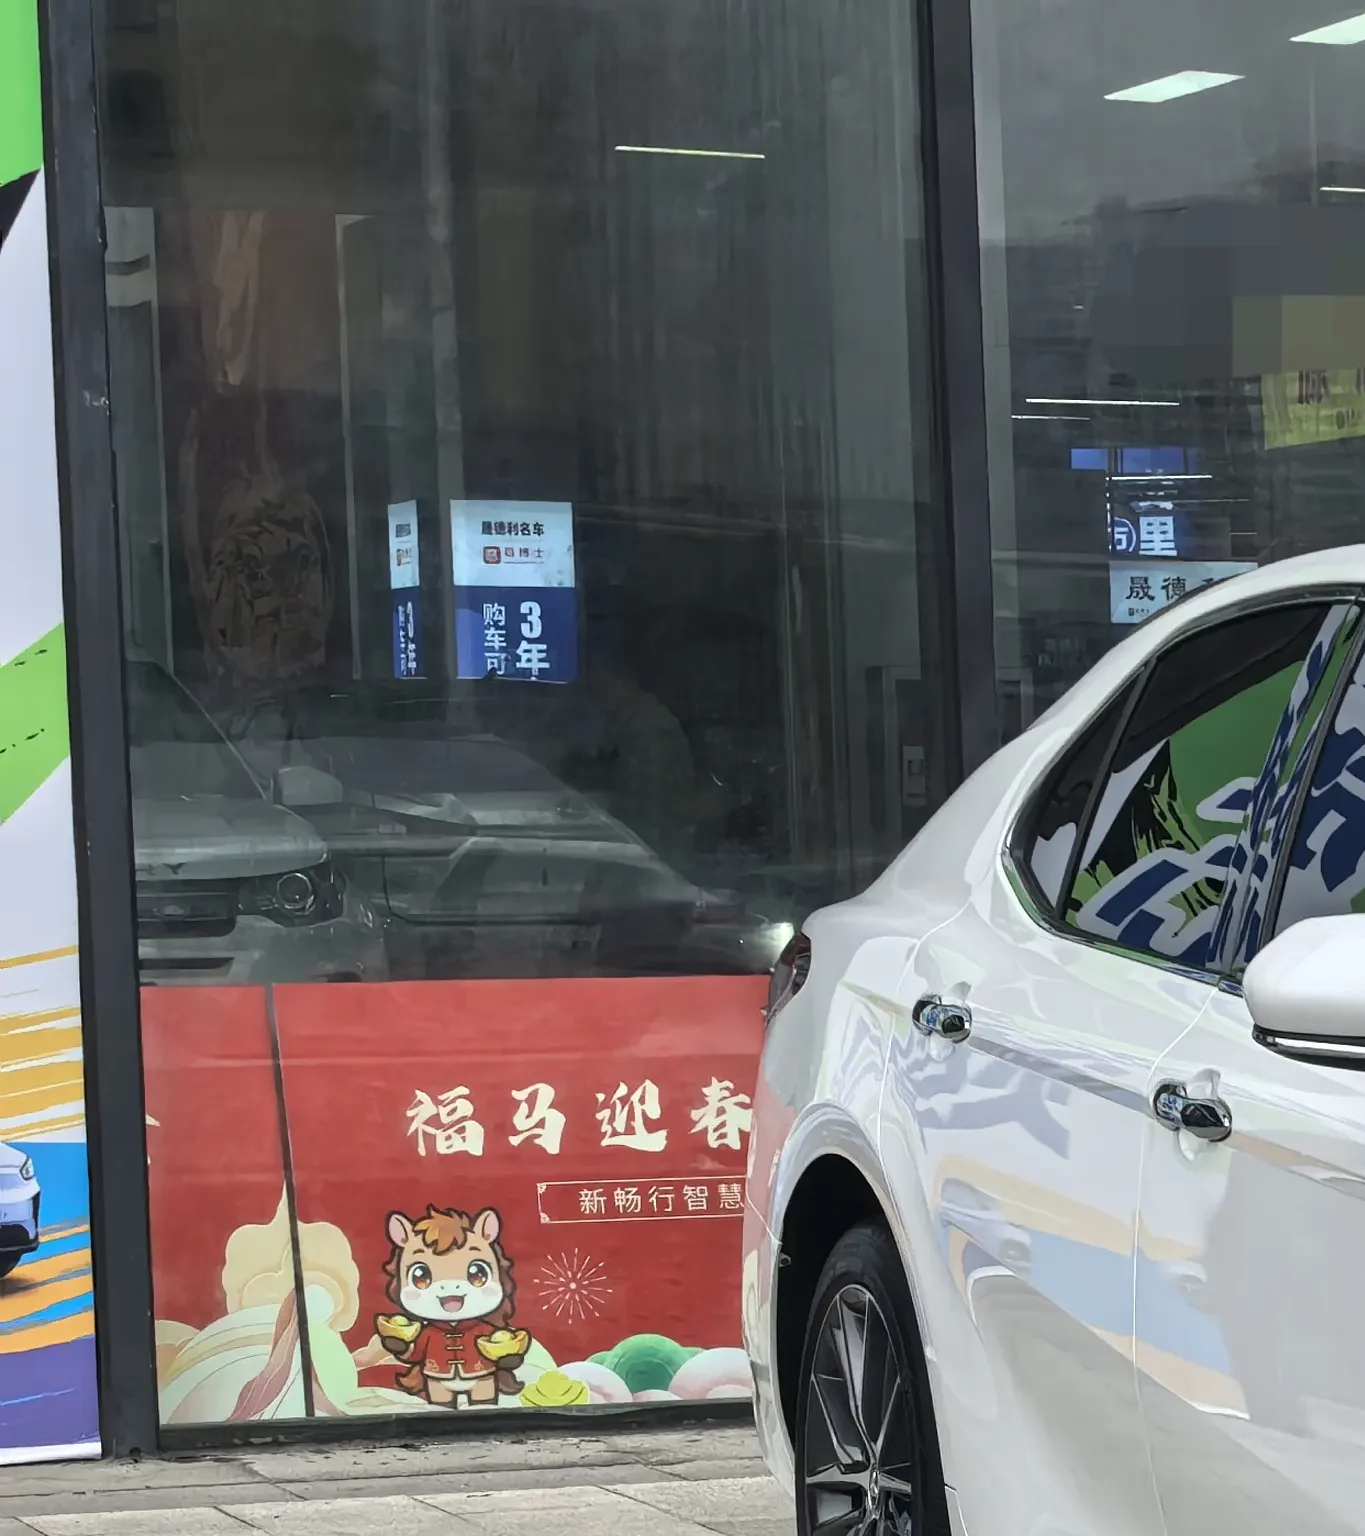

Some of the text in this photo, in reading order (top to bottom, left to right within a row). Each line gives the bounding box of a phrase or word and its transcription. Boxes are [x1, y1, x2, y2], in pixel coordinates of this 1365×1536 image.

[1125, 576, 1226, 601] 晟德
[482, 603, 507, 676] 购车可
[405, 1076, 754, 1157] 福马迎春
[578, 1182, 746, 1215] 新畅行智慧
